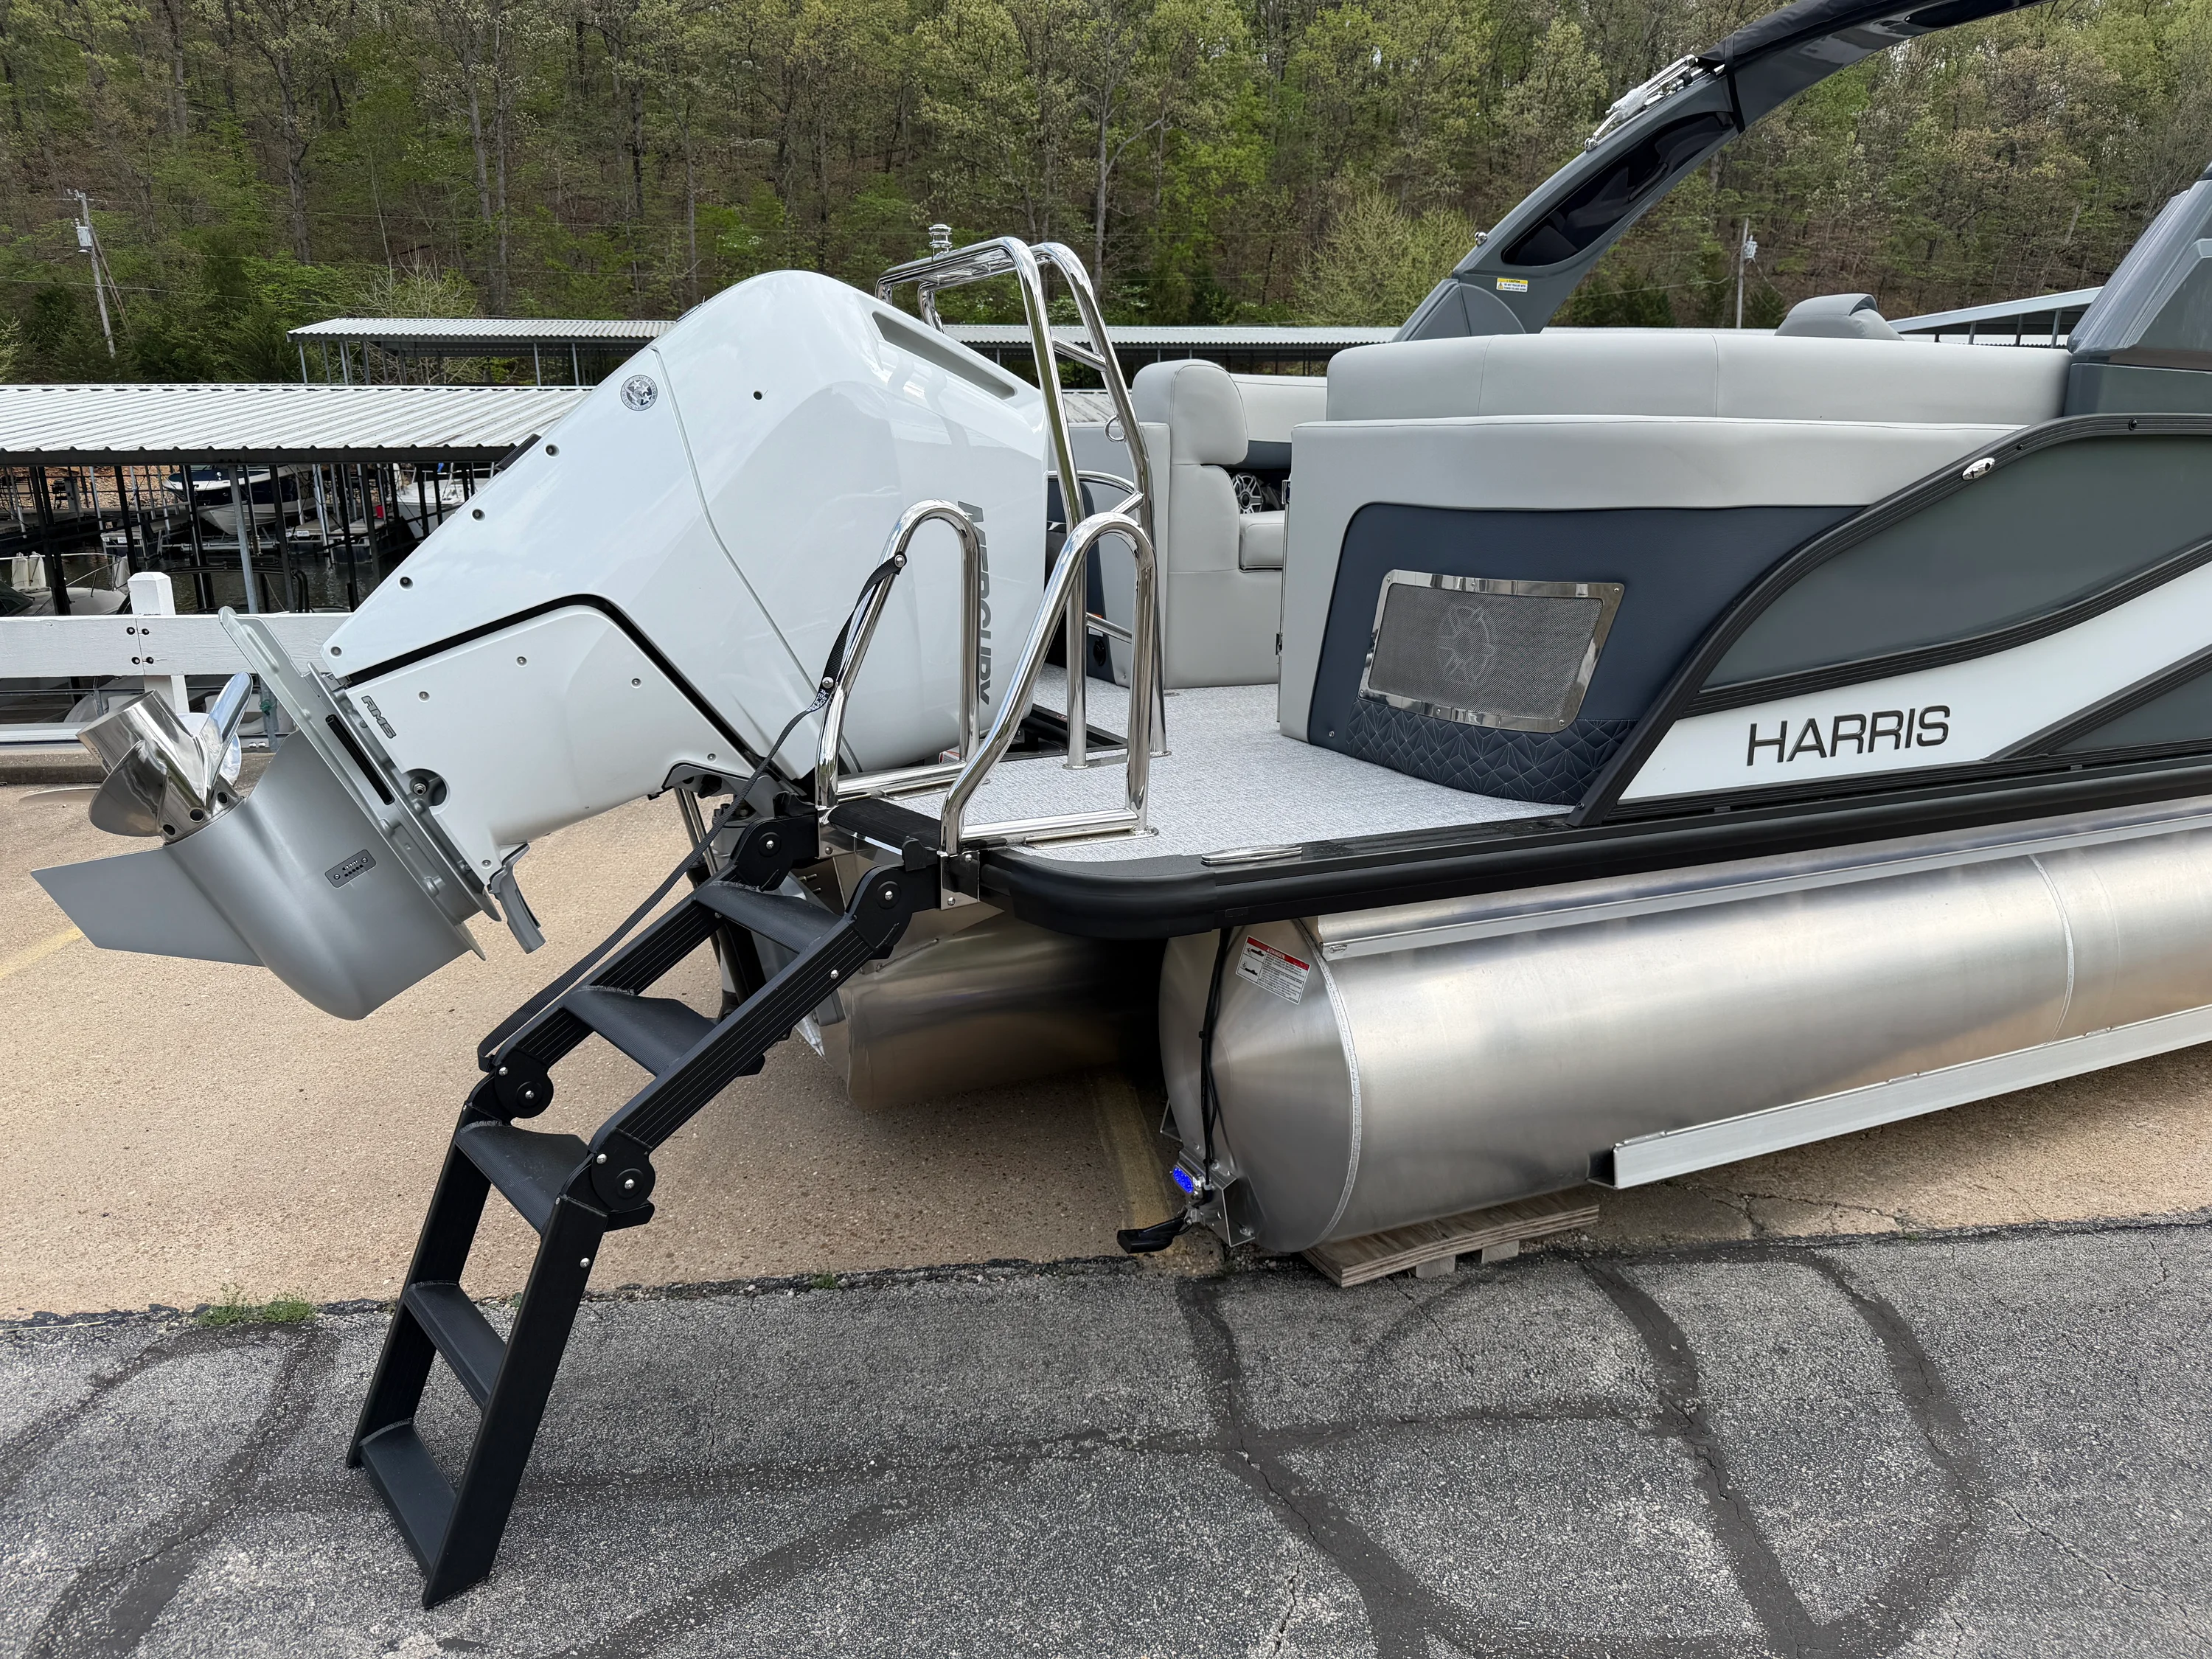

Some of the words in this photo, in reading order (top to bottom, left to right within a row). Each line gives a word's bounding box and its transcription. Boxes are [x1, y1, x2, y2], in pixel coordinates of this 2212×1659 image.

[361, 695, 397, 739] AMS
[1747, 705, 1950, 766] HARRIS
[1269, 948, 1285, 959] DANGER
